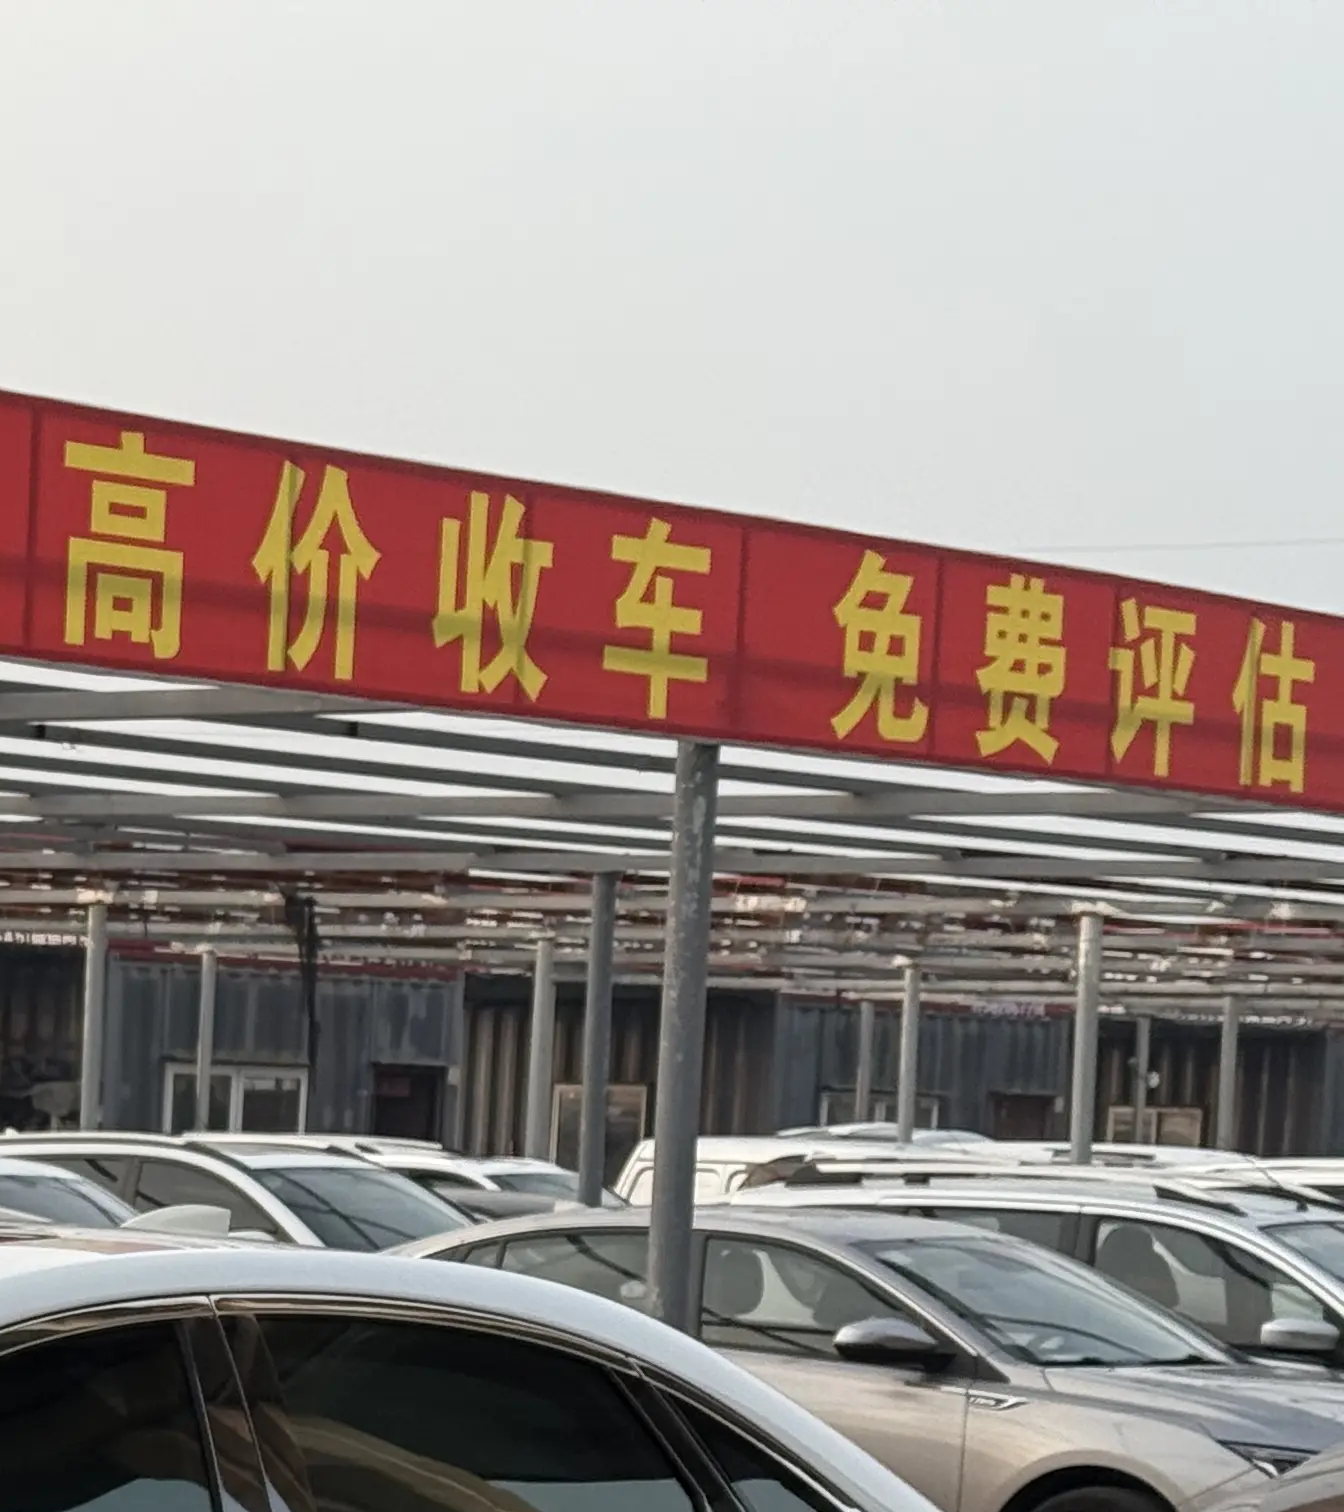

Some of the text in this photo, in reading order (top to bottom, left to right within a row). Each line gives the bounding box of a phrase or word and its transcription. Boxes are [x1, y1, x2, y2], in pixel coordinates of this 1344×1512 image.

[64, 432, 710, 719] 高价收车
[831, 550, 1315, 792] 免费评估
